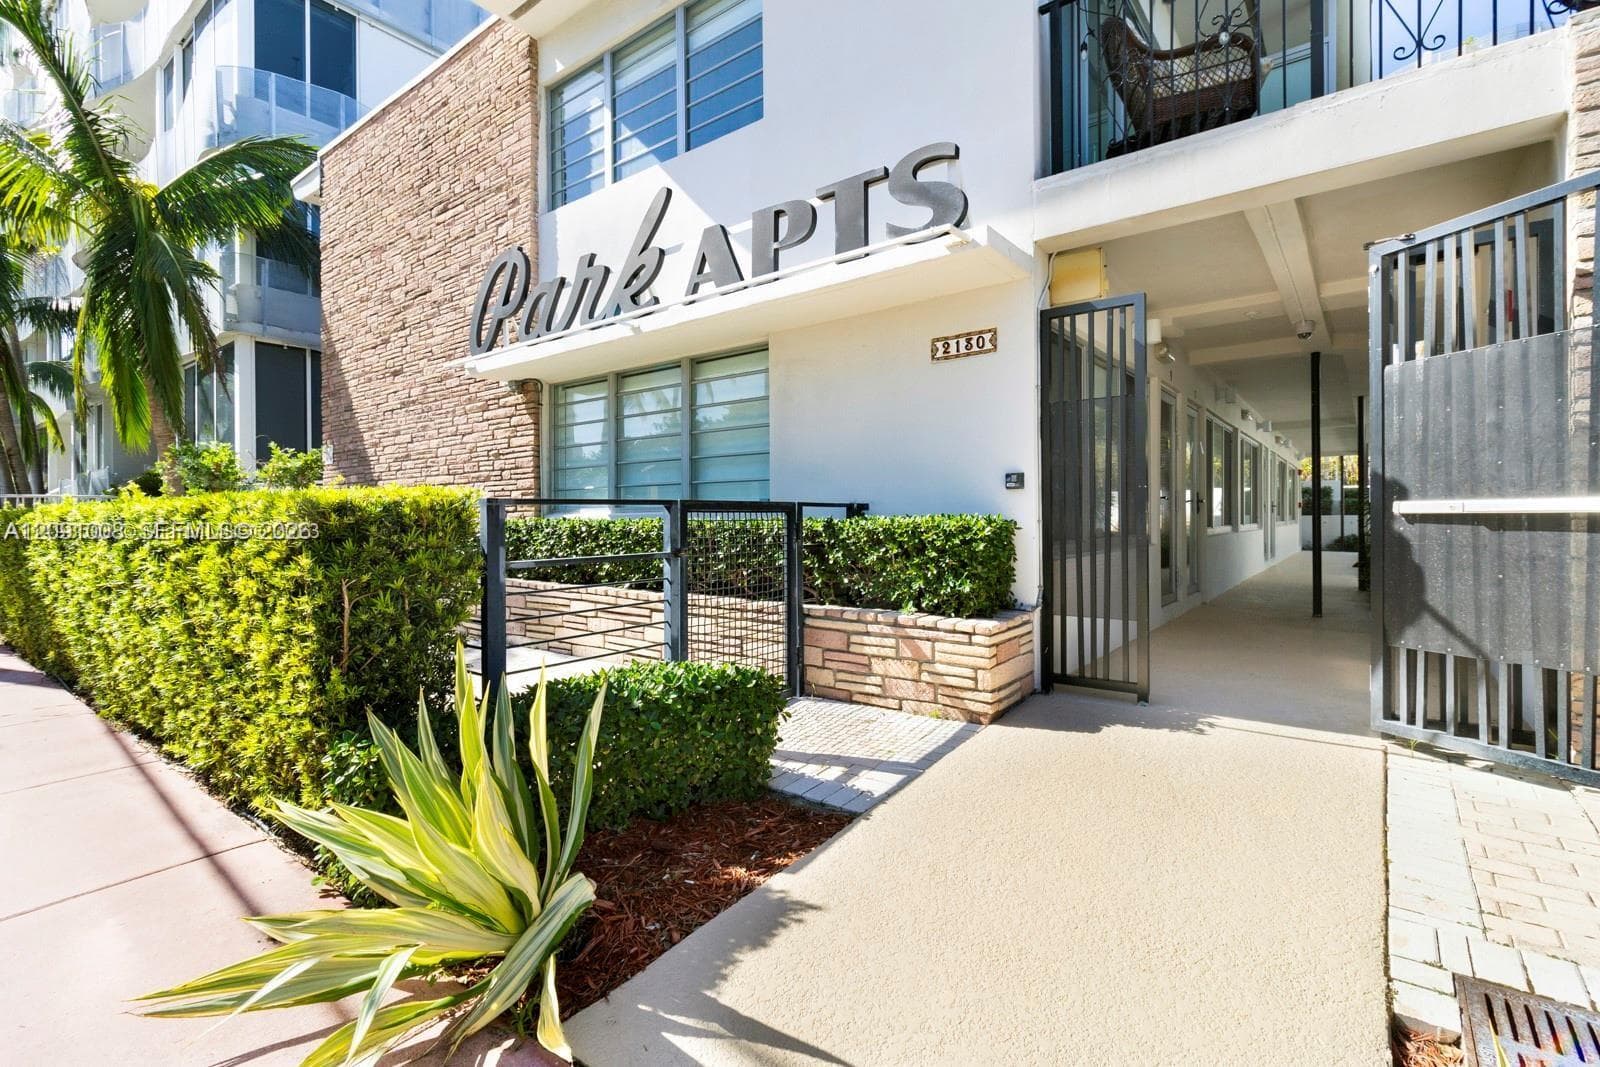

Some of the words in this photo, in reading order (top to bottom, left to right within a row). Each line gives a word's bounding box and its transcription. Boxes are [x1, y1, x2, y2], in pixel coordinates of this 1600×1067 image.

[469, 186, 673, 357] Park
[684, 141, 970, 306] APTS
[942, 335, 986, 355] 2130
